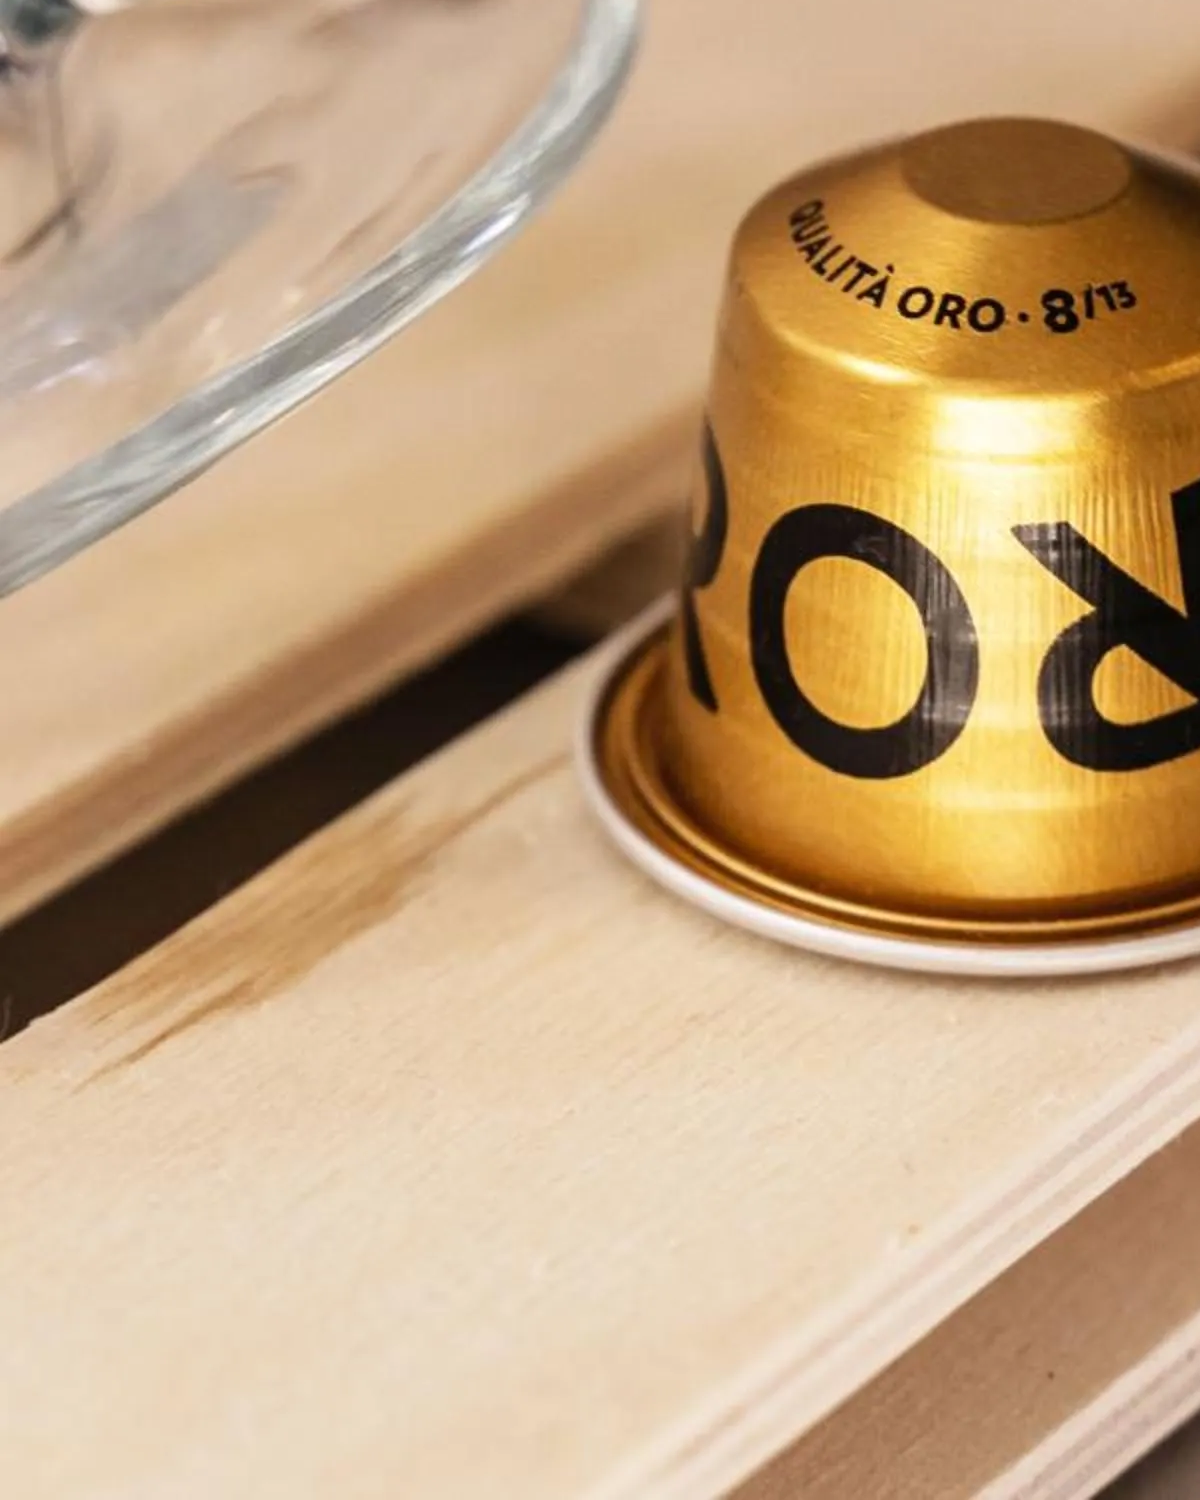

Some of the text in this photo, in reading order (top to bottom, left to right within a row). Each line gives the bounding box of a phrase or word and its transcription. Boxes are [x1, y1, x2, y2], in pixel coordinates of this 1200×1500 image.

[789, 199, 1138, 334] QUALITÀ ORO 8/13
